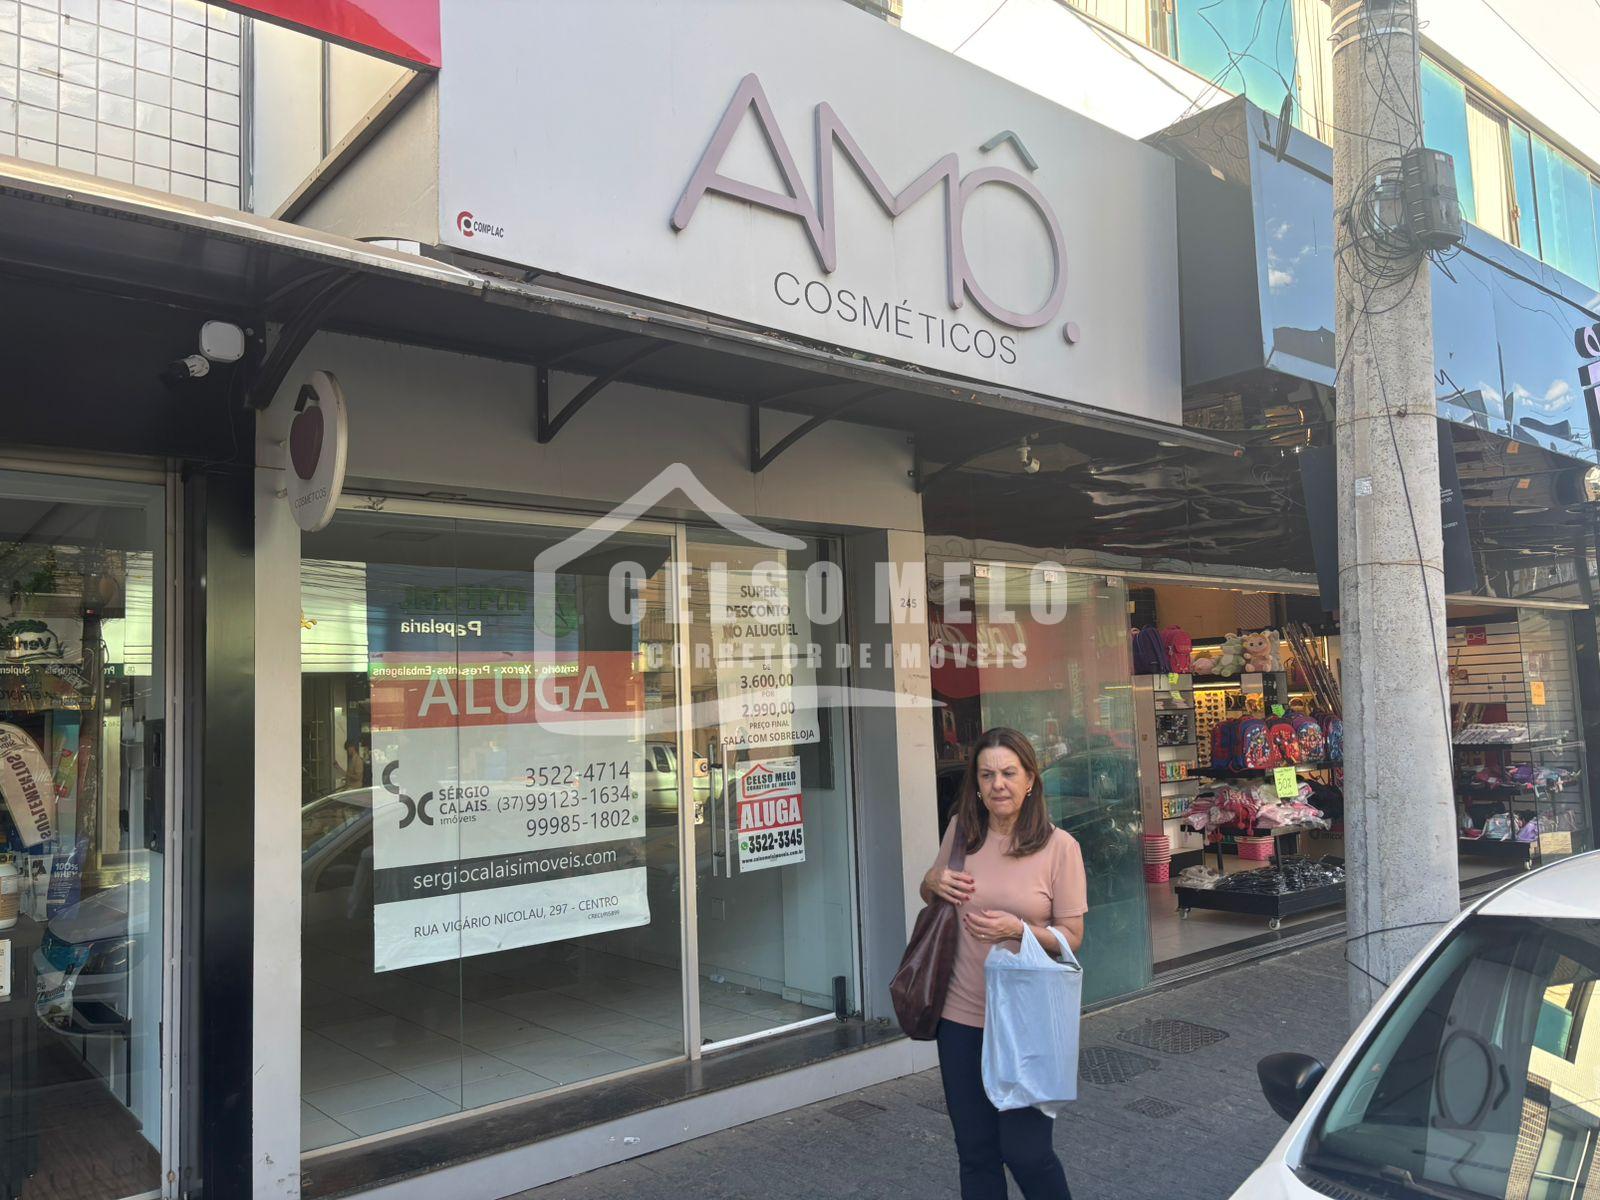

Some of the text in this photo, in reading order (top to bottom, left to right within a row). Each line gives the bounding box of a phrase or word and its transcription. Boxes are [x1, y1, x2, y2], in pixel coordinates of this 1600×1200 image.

[473, 221, 504, 238] COMPLAC
[774, 271, 1017, 365] COSMÉTICOS
[740, 585, 778, 598] SUPER
[726, 604, 790, 619] DESCONTO
[900, 598, 917, 609] 245
[745, 623, 798, 638] ALUGUEL
[740, 673, 793, 689] 3.600,00
[417, 664, 609, 718] ALUGA
[742, 701, 795, 719] 2.990,00
[749, 719, 790, 730] PREÇO FINAL
[723, 730, 815, 746] SALA COM SOBRELOJA
[525, 761, 631, 788] 3522-4714
[746, 771, 796, 786] CELSO MELO
[439, 785, 490, 802] SÉRGIO
[497, 786, 631, 813] (37) 99123-1634
[439, 799, 488, 815] CALAIS
[740, 797, 801, 830] ALUGA
[440, 814, 477, 826] imóveis
[526, 809, 631, 837] 99985-1802
[748, 828, 802, 854] 3522-3345
[413, 847, 617, 890] sergiocalaisimoveis.com
[413, 925, 440, 939] RUA
[442, 915, 491, 934] VIGÁRIO
[494, 907, 547, 926] NICOLAU,
[549, 903, 568, 917] 297
[578, 895, 620, 912] CENTRO
